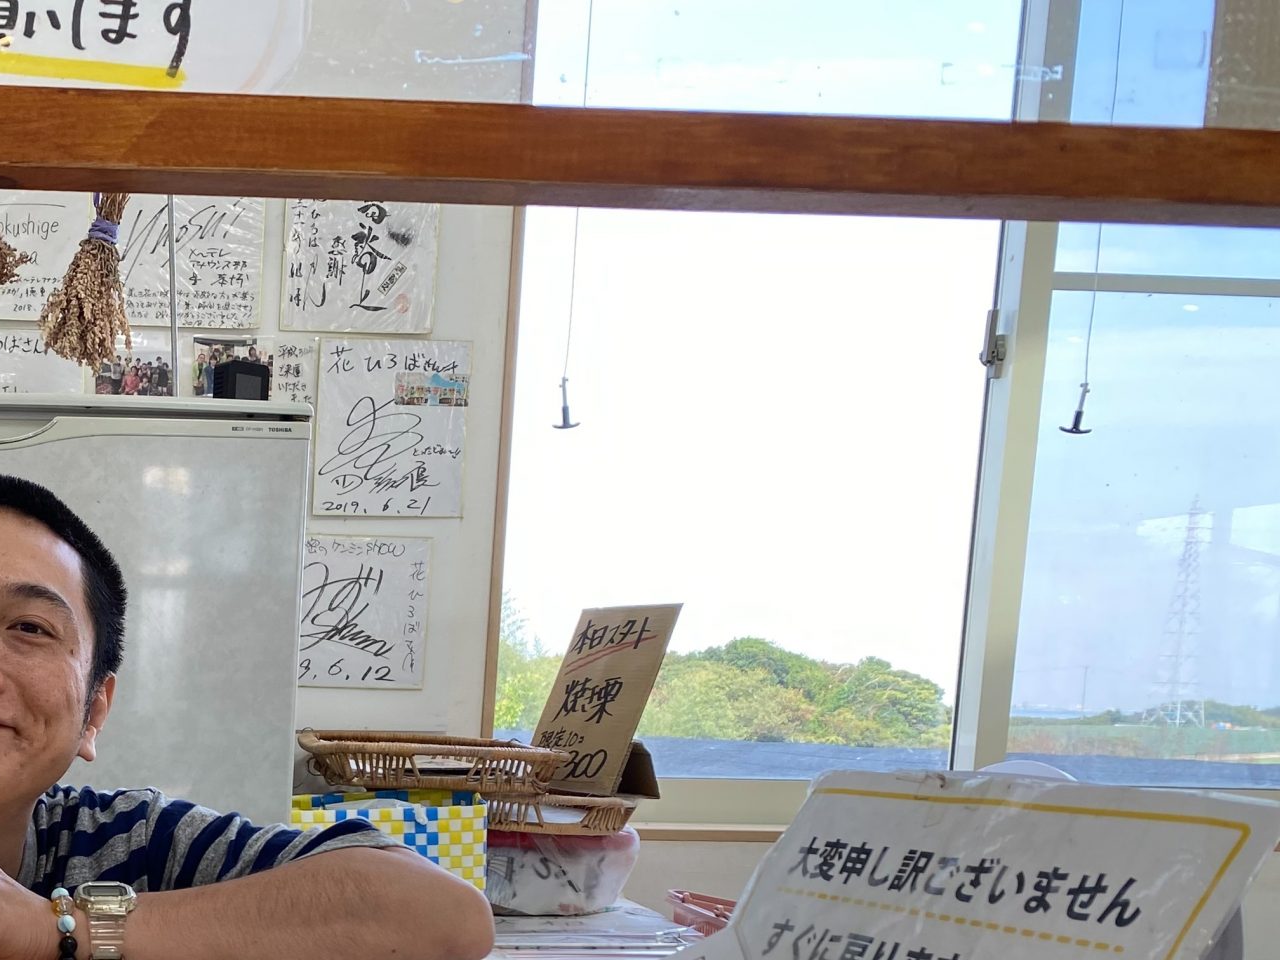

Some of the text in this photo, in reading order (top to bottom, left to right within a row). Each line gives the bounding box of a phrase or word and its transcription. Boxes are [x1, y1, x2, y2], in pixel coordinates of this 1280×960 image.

[570, 617, 652, 655] 本日スタート
[788, 835, 1143, 929] 大変申し訳ございません
